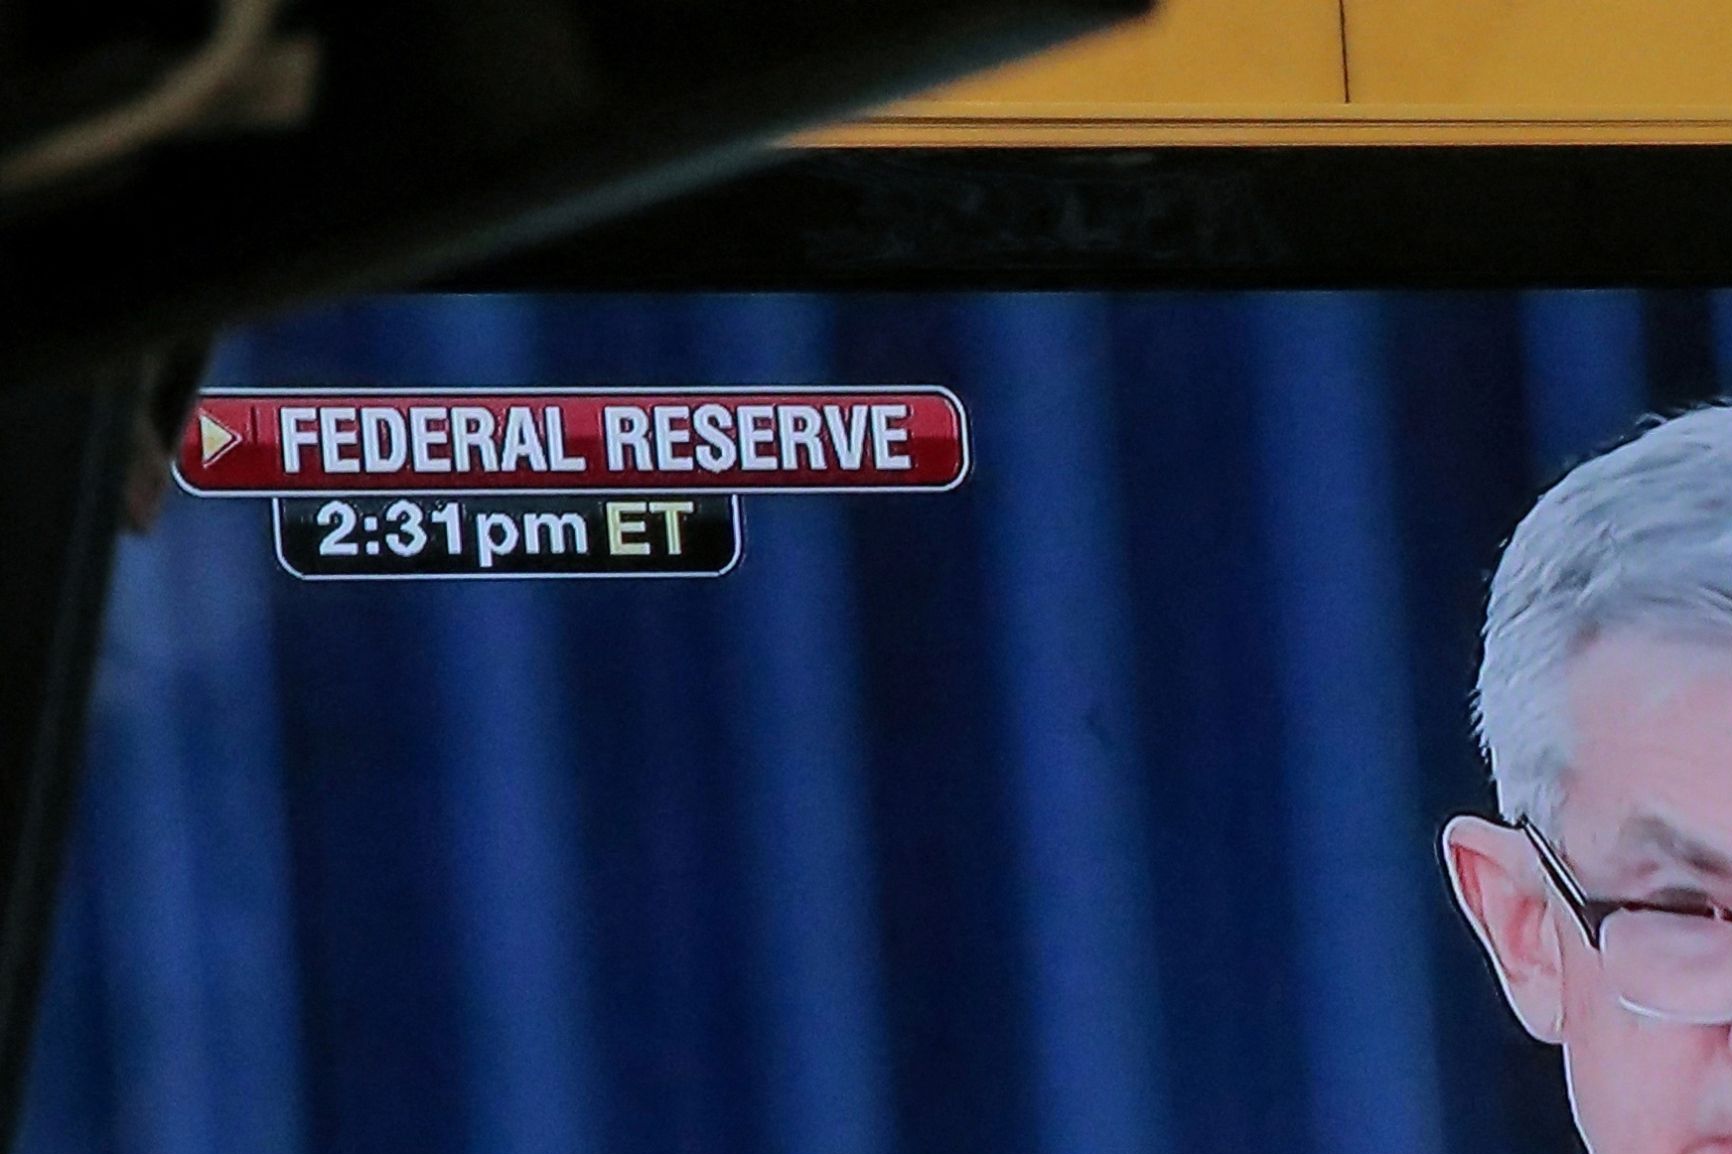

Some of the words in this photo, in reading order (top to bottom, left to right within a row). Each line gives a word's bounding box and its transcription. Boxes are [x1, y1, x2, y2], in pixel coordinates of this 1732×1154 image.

[279, 406, 587, 475] FEDERAL
[604, 404, 912, 472] RESERVE
[316, 500, 588, 568] 2:31pm
[606, 501, 695, 555] ET
